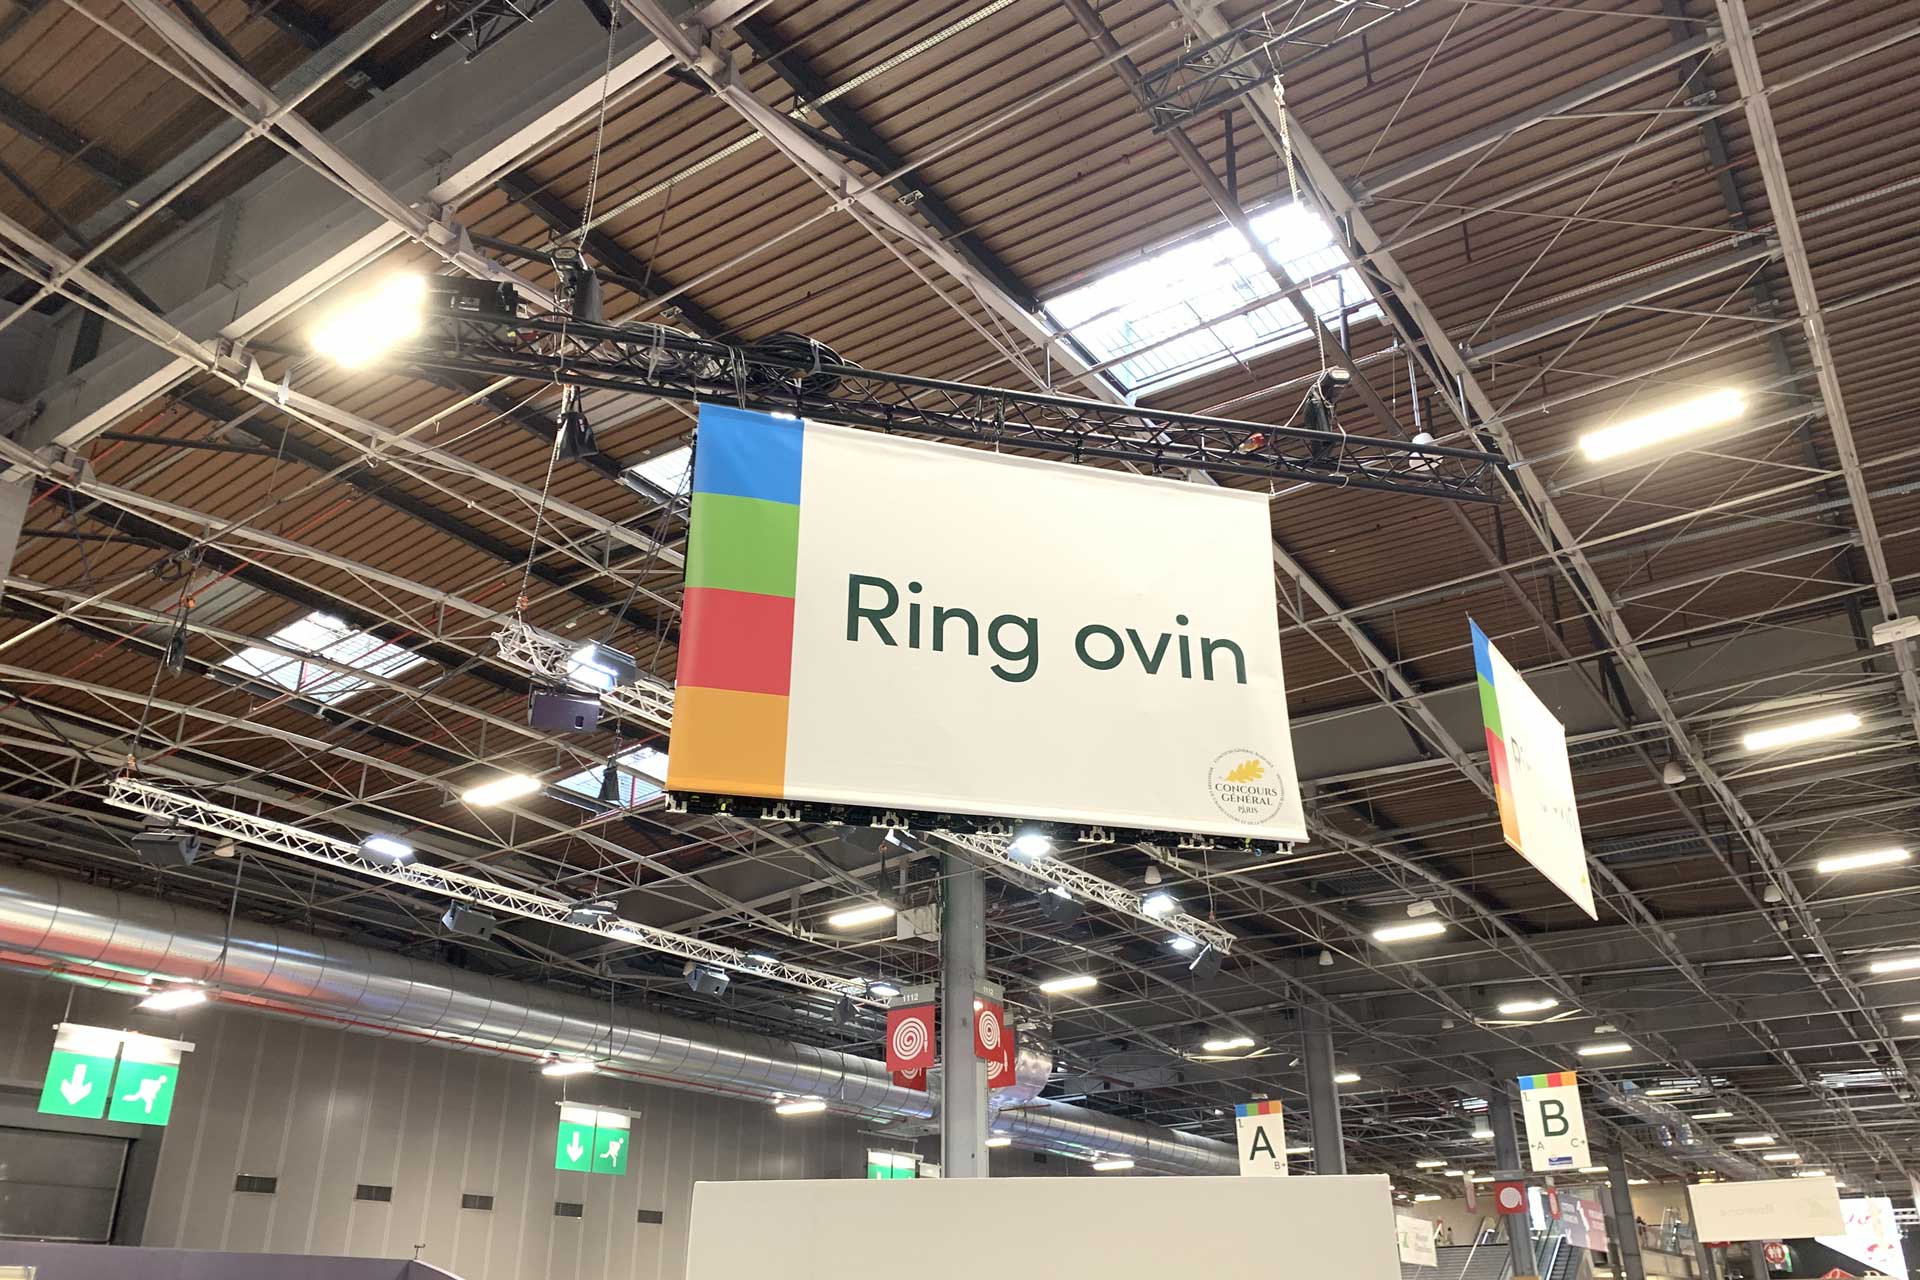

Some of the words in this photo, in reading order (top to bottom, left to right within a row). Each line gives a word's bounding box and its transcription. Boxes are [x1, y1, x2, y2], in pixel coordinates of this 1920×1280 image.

[847, 574, 1038, 682] Ring
[1075, 615, 1247, 684] ovin
[1215, 783, 1278, 797] CONCOURS
[1221, 793, 1273, 806] GÉNÉRAL
[1238, 804, 1259, 814] PARIS
[902, 992, 919, 1003] 1112
[1539, 1099, 1569, 1137] B
[1249, 1126, 1276, 1161] A
[1537, 1141, 1545, 1150] A
[1570, 1138, 1579, 1148] C
[1274, 1161, 1281, 1170] B
